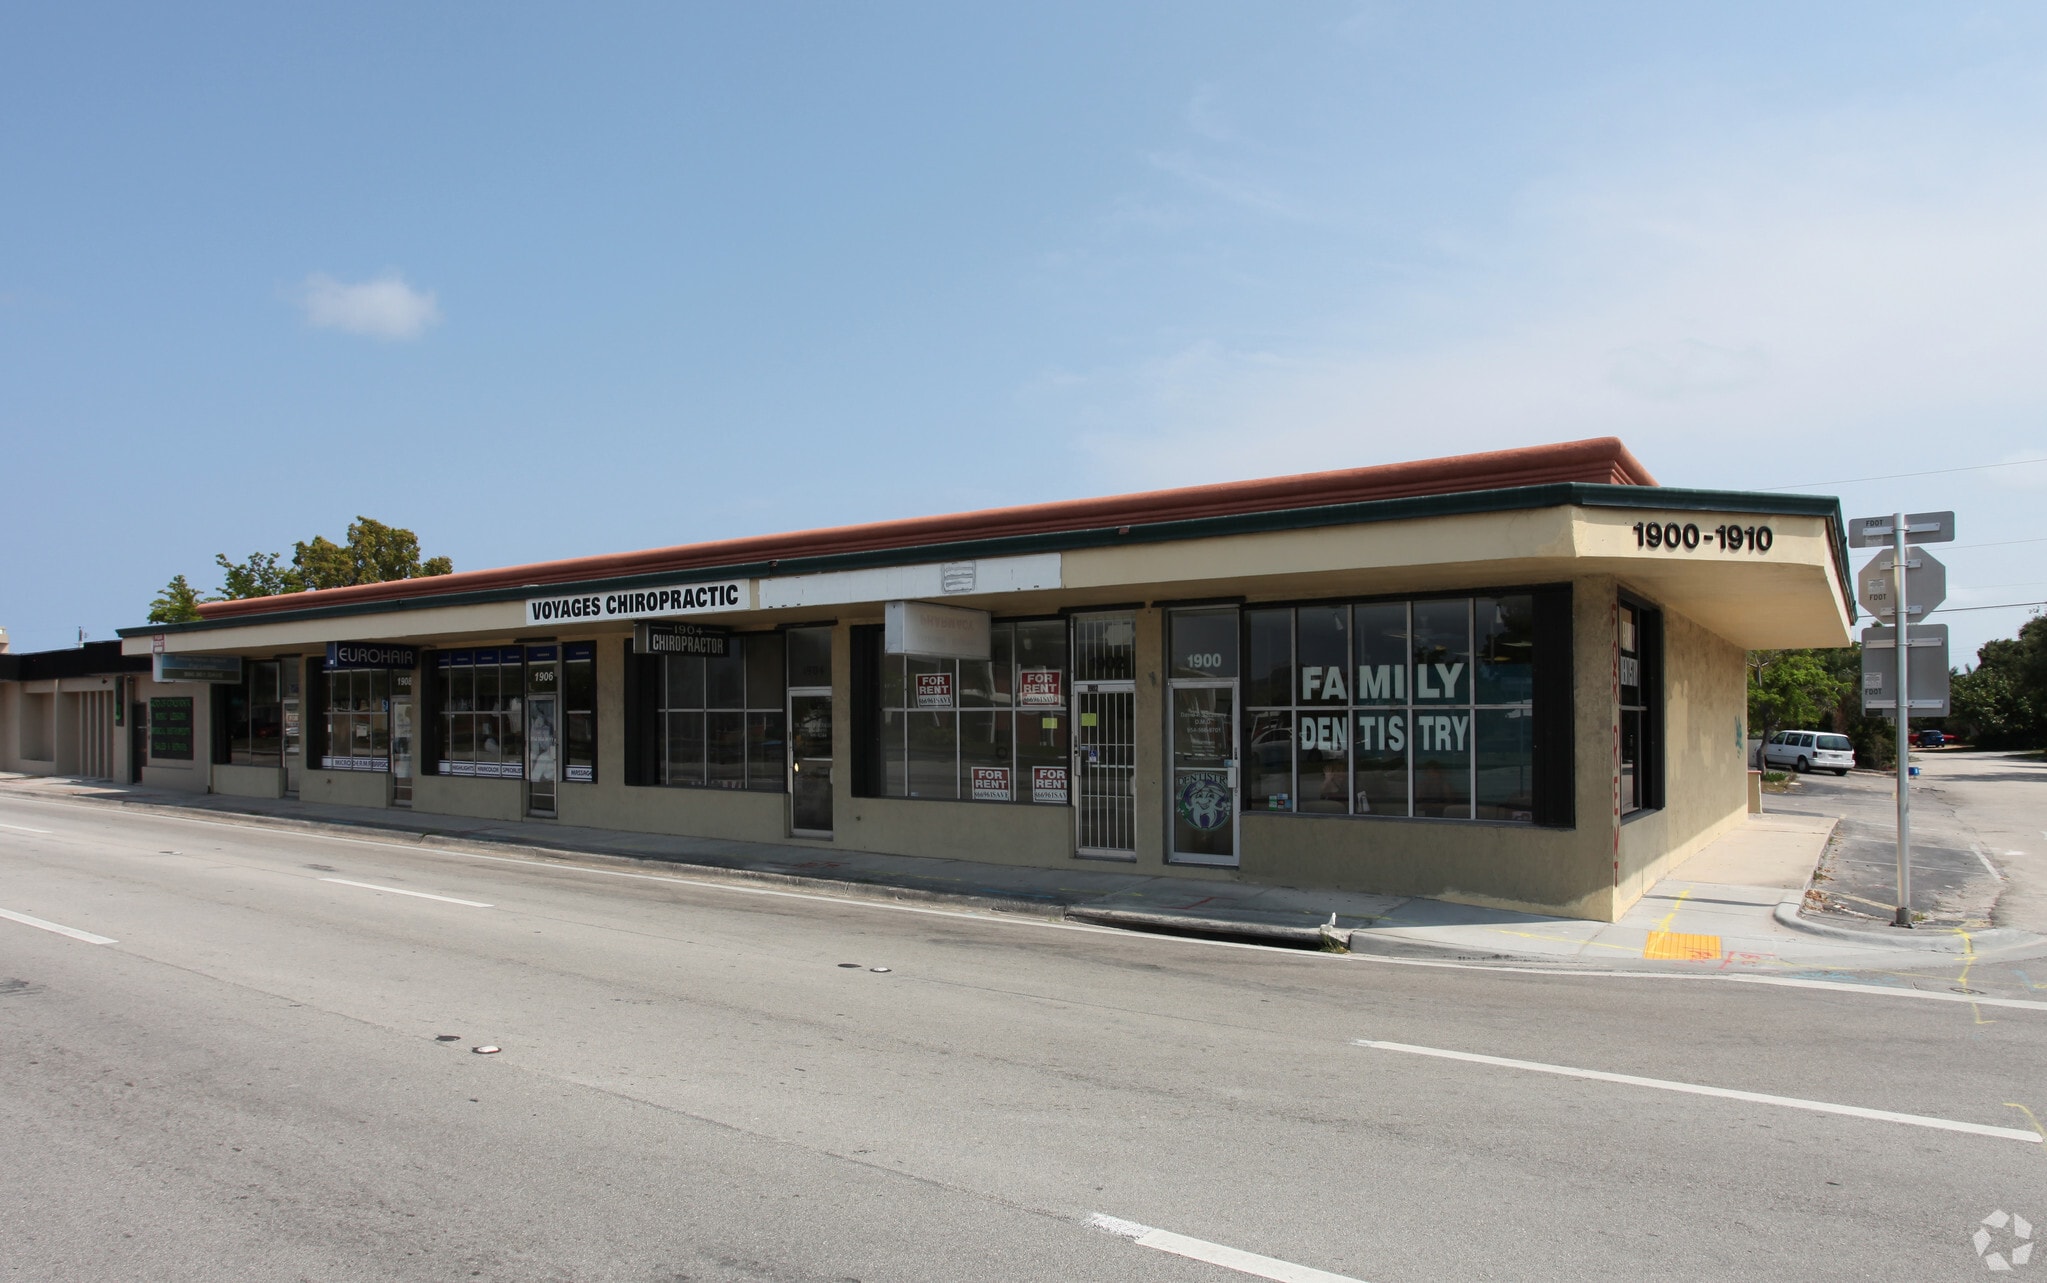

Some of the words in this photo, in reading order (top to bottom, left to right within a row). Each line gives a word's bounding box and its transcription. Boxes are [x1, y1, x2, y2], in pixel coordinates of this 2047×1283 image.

[1633, 521, 1773, 551] 1900-1910
[532, 597, 600, 620] VOYAGES
[606, 584, 738, 615] CHIROPRACTIC
[652, 634, 724, 654] CHIROPRACTOR
[338, 647, 413, 665] EUROHAIR
[1187, 653, 1222, 668] 1900
[534, 671, 554, 682] 1906
[922, 676, 945, 685] FOR
[1027, 673, 1053, 683] FOR
[919, 685, 949, 694] RENT
[1023, 683, 1057, 693] RENT
[978, 770, 1003, 779] FOR
[1040, 769, 1066, 779] FOR
[975, 779, 1006, 789] RENT
